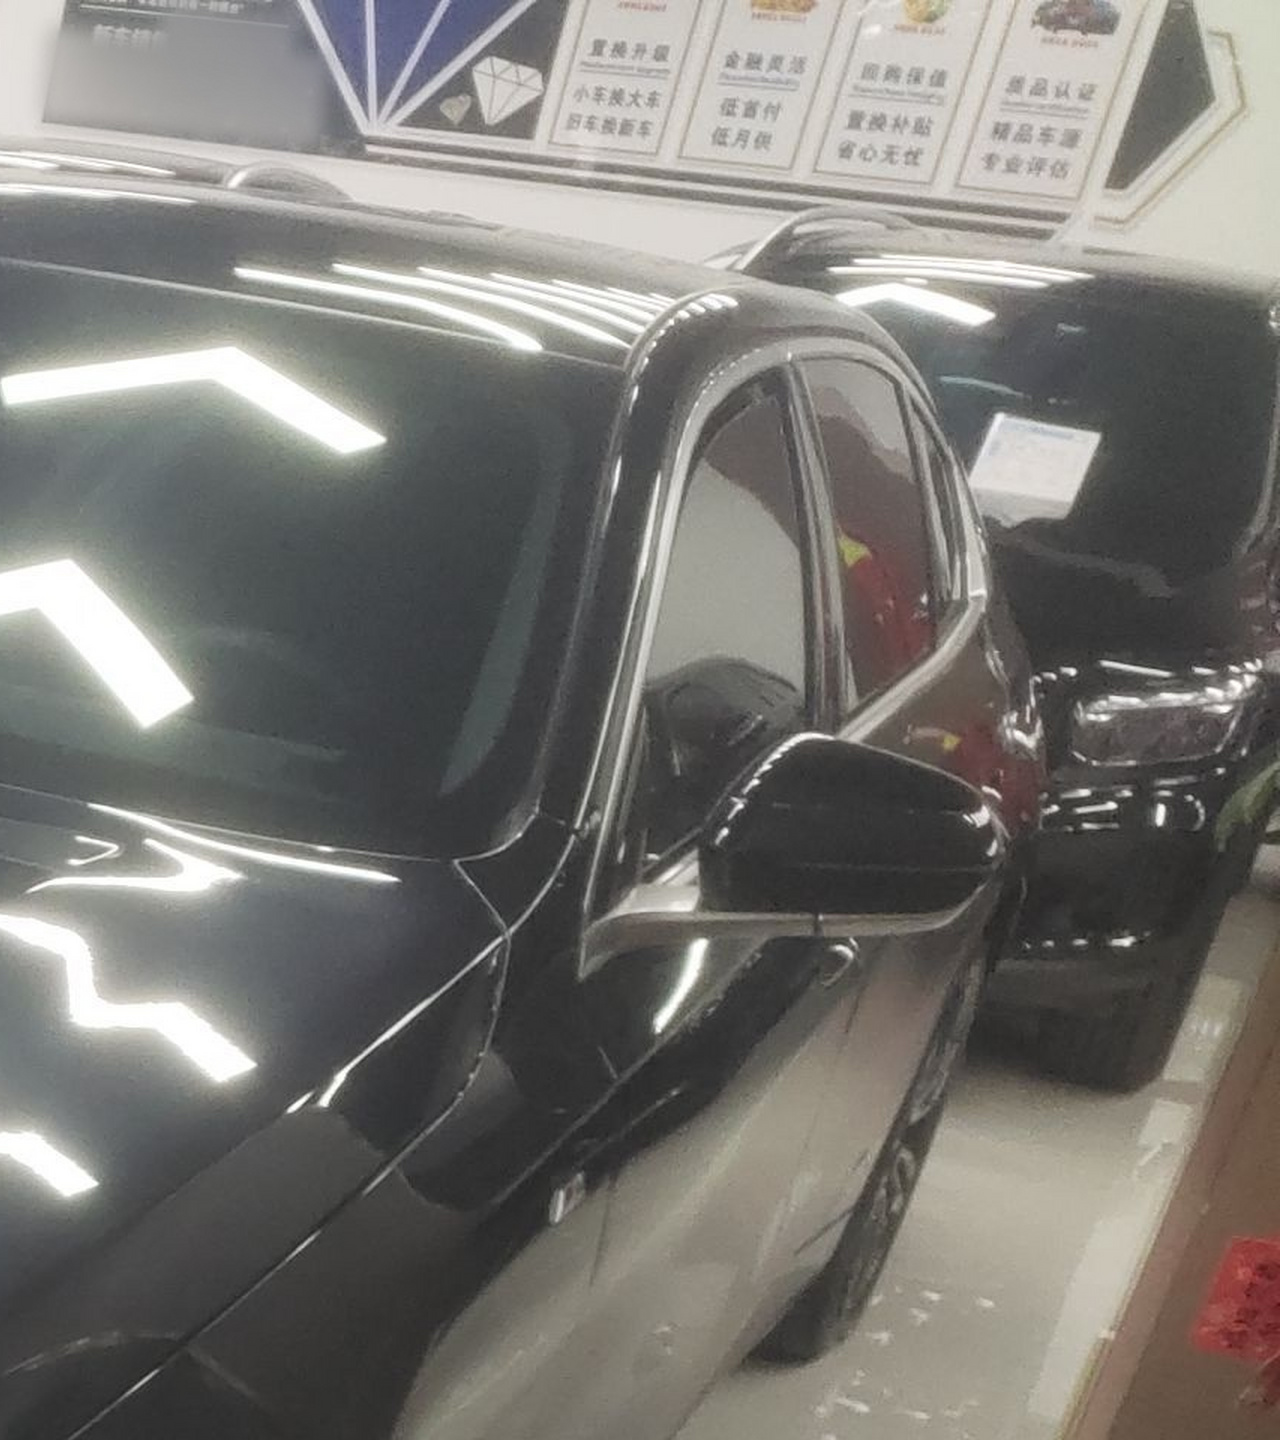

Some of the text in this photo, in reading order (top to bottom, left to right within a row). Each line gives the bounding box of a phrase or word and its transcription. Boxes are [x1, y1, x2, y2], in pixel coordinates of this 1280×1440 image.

[573, 85, 661, 108] 小车换大车
[720, 97, 782, 121] 低首付
[845, 110, 934, 136] 置换补贴
[711, 126, 773, 150] 低月供
[838, 140, 924, 166] 省心无忧
[981, 153, 1071, 179] 专业评估
